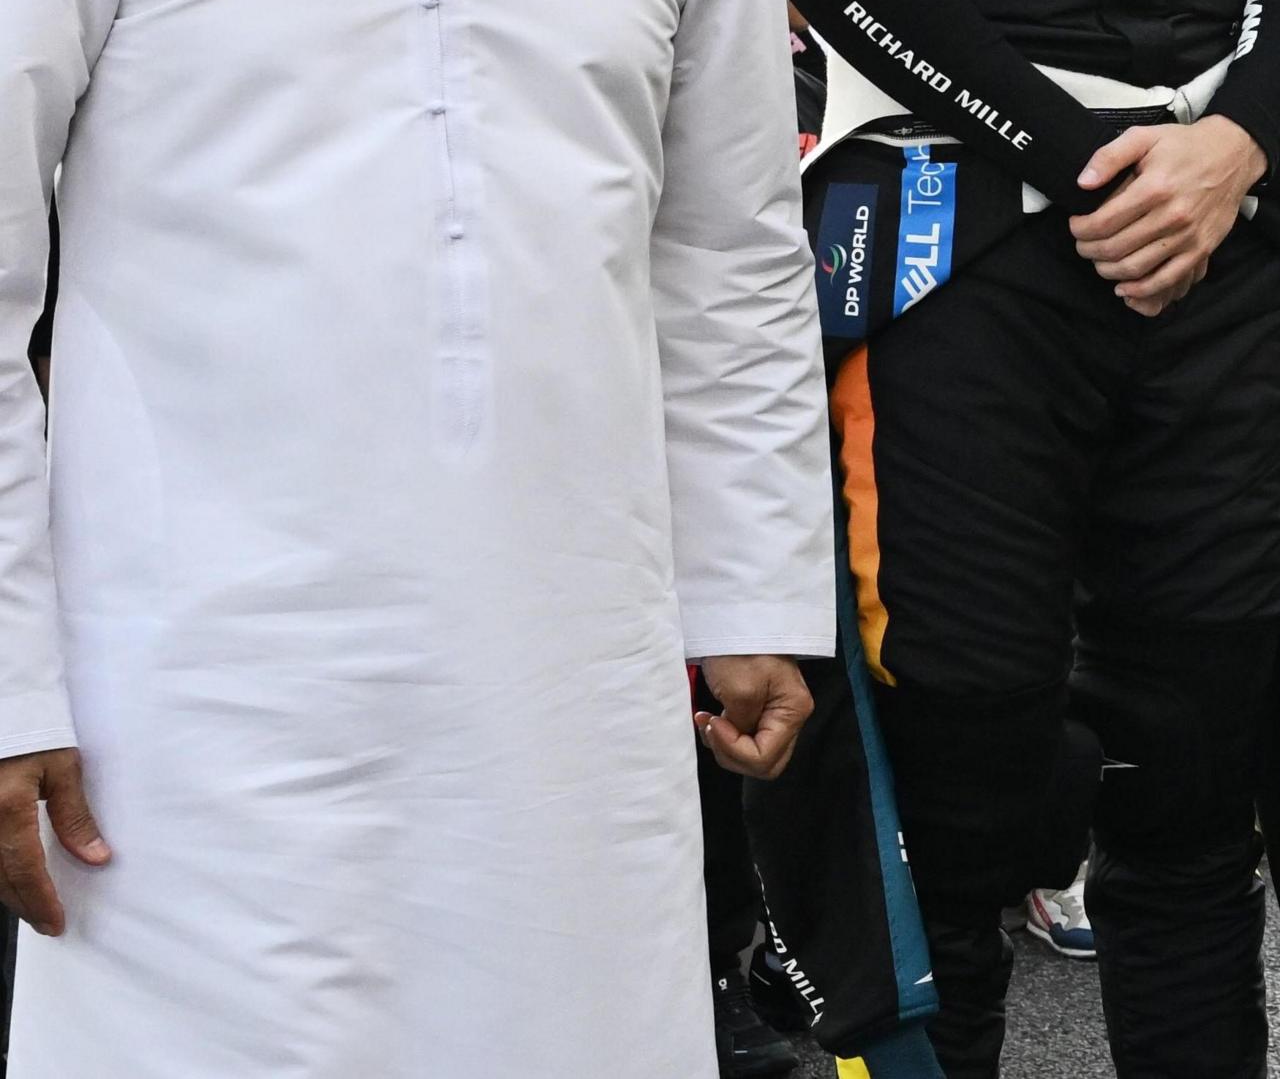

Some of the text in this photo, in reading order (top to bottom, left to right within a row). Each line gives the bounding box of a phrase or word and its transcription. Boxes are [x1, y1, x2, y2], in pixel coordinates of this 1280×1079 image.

[842, 0, 1033, 151] RICHARD MILLE
[844, 204, 870, 318] DP WORLD
